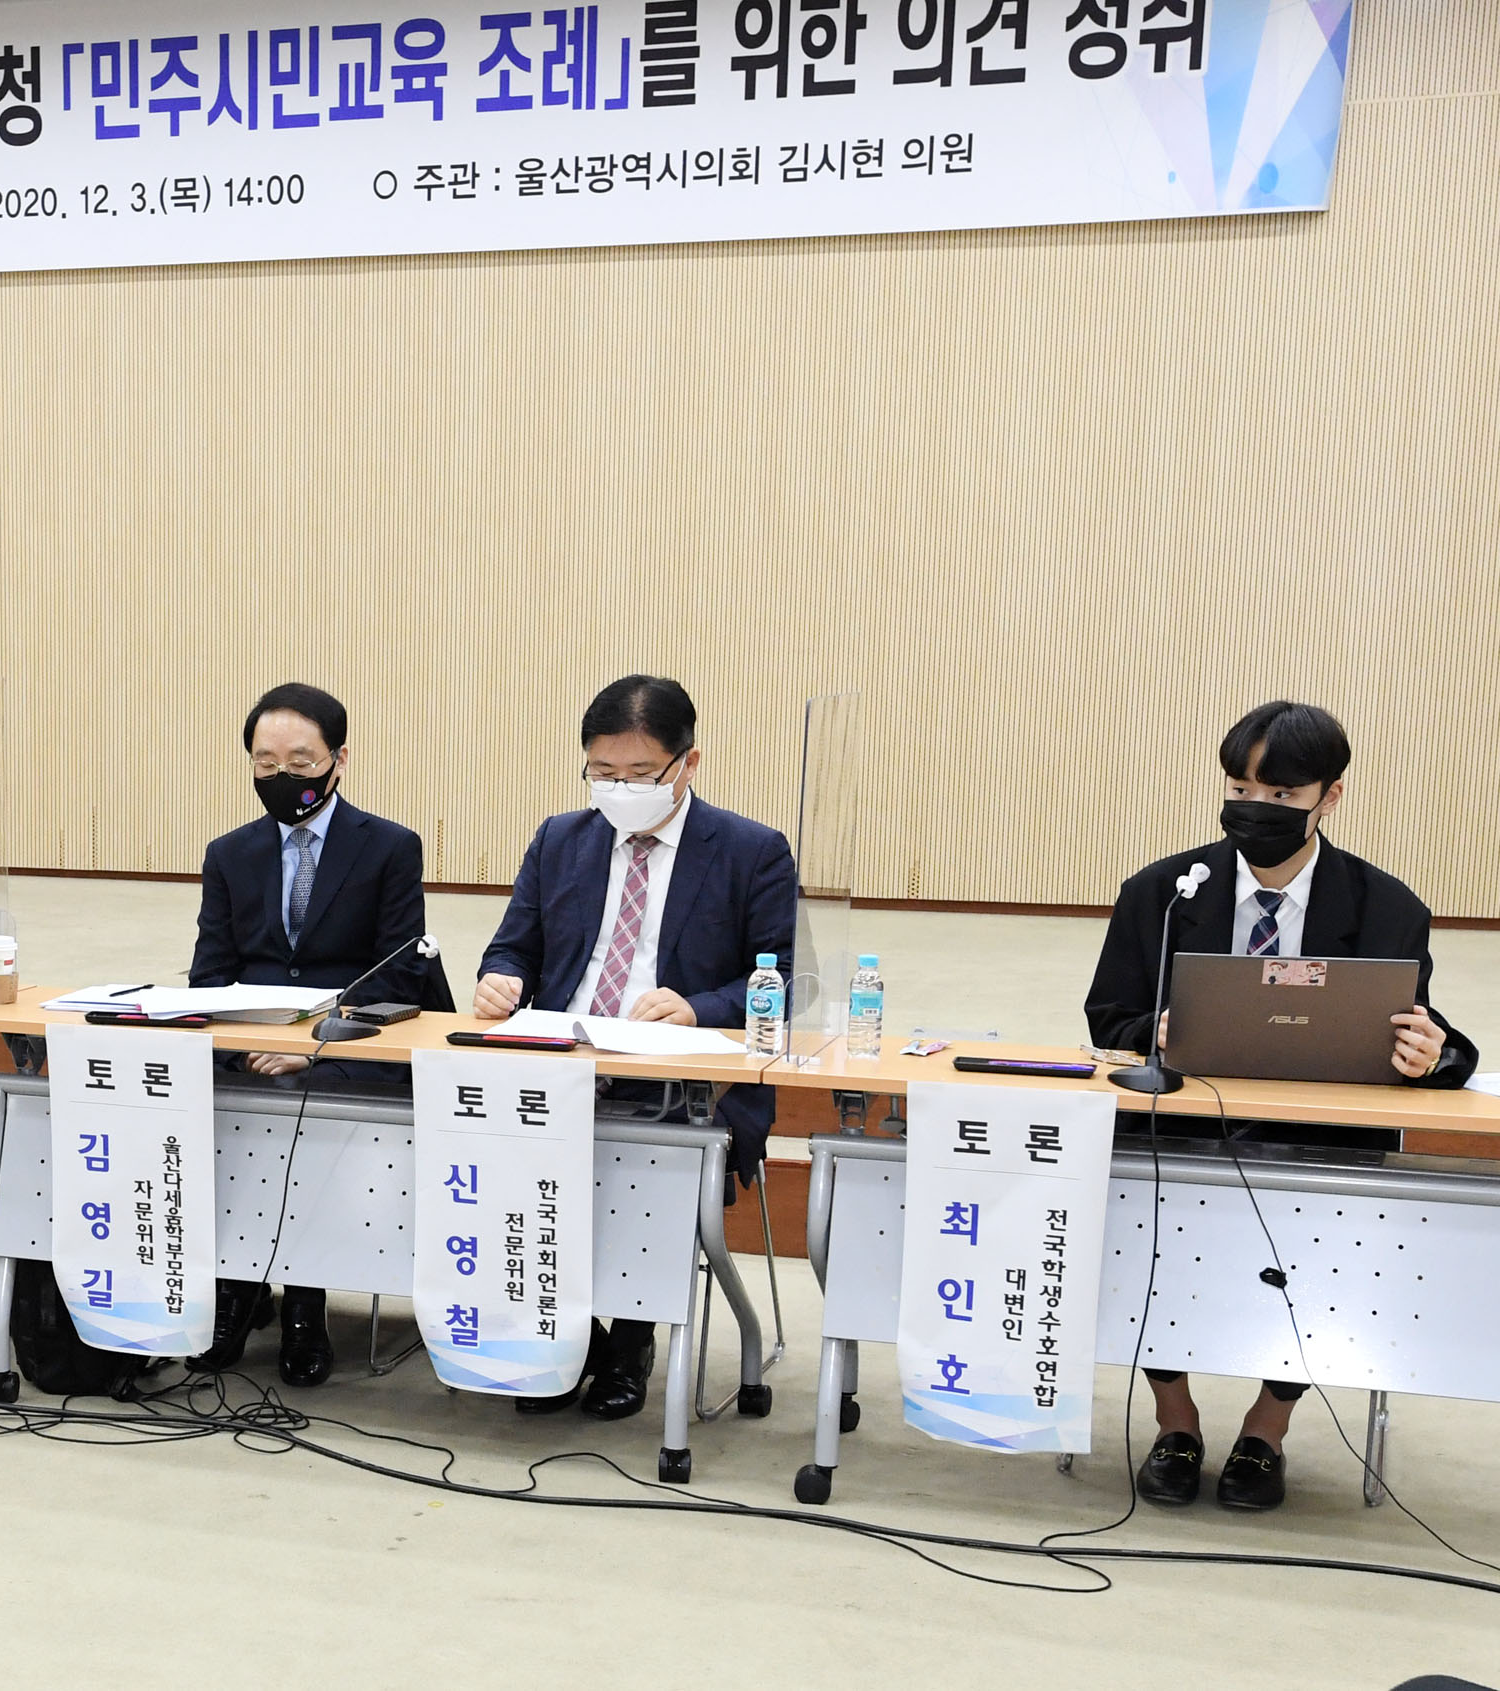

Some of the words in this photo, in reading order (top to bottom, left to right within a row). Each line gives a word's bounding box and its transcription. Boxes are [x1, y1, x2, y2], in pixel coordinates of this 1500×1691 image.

[730, 0, 868, 101] 위한
[892, 0, 1030, 88] 의견
[79, 184, 118, 217] 12.
[223, 173, 305, 208] 14:00
[413, 161, 481, 202] 주관
[514, 145, 761, 197] 울산광역시의회
[778, 137, 884, 184] 김시현
[900, 132, 974, 176] 의원
[1267, 1015, 1310, 1025] ASUS
[133, 1179, 155, 1266] 자문위원
[161, 1135, 185, 1315] 울산다세움학부모연합
[503, 1212, 526, 1303] 전문위원
[536, 1178, 560, 1341] 한국교회언론회
[1001, 1268, 1027, 1342] 대변인
[1032, 1209, 1068, 1408] 전국학생수호연합
